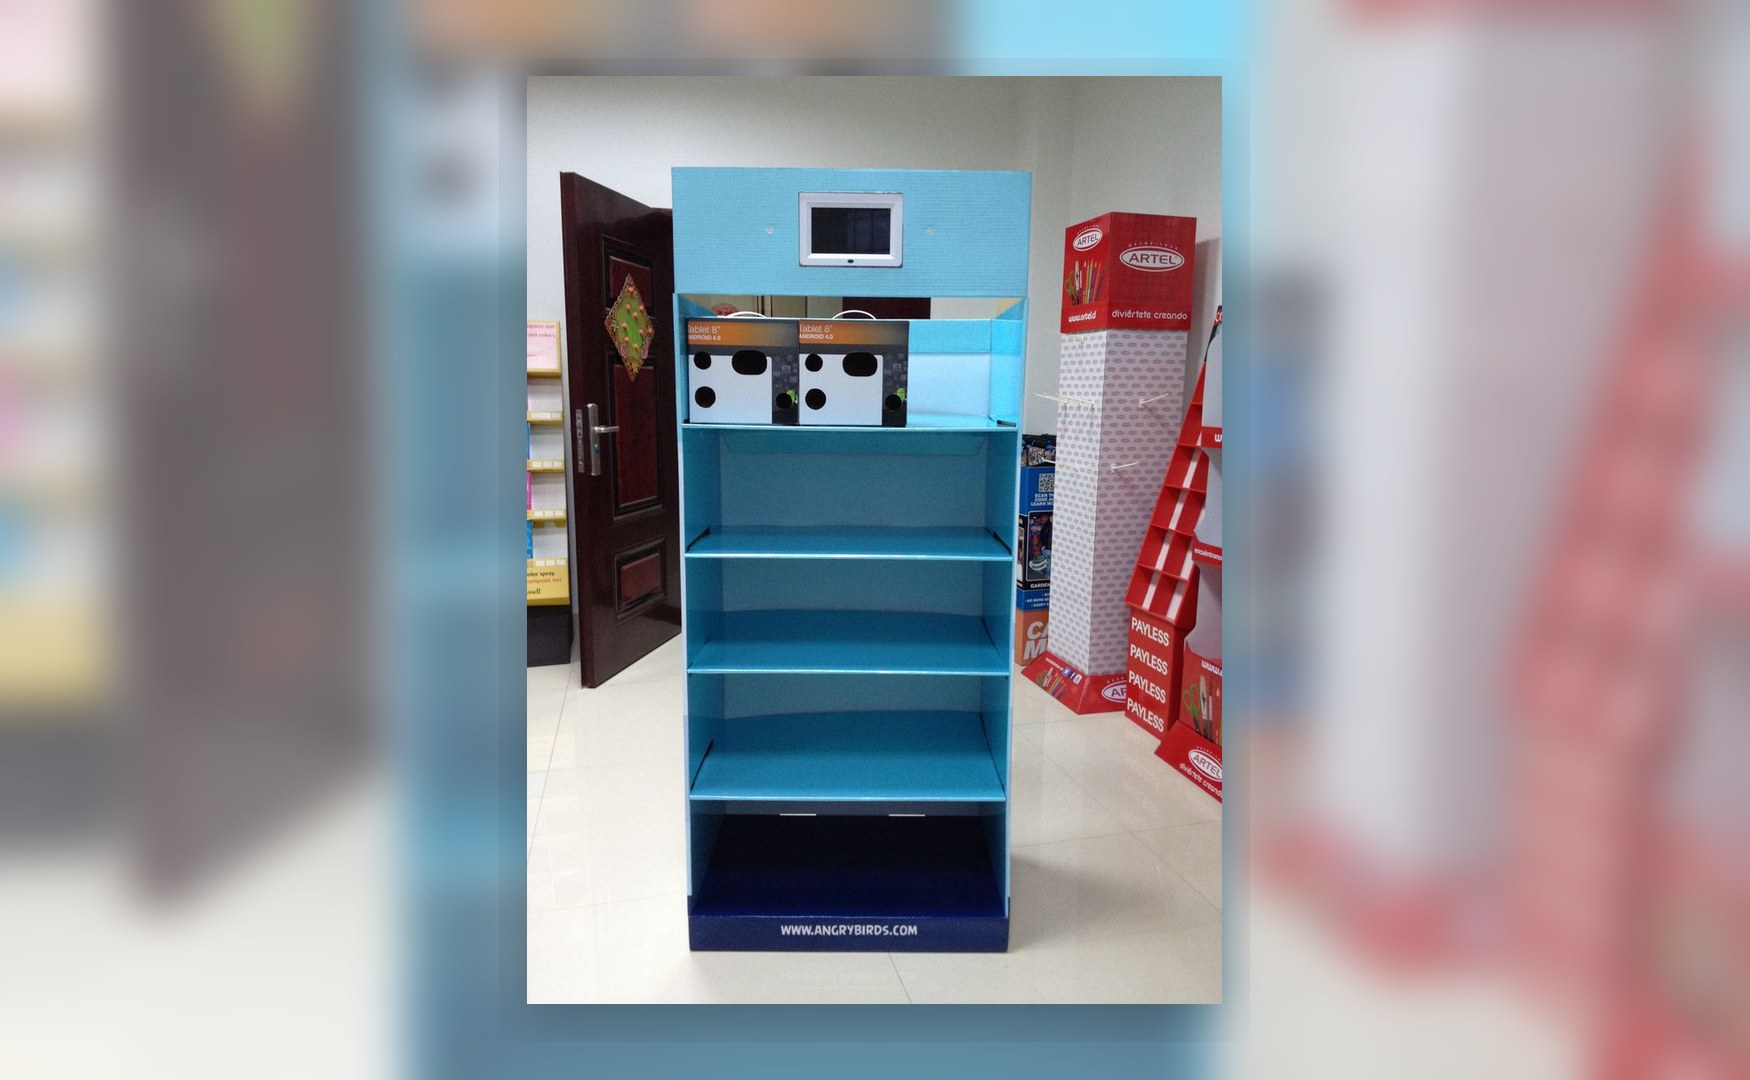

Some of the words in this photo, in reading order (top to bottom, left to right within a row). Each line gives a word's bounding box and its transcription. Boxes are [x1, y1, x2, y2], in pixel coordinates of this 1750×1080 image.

[1077, 233, 1099, 246] ARTEL
[1128, 253, 1177, 265] ARTEL
[1112, 309, 1151, 319] diviértete
[1154, 309, 1188, 320] creando
[1131, 616, 1169, 647] PAYLESS
[1130, 644, 1168, 676] PAYLESS
[1128, 670, 1166, 704] PAYLESS
[1126, 697, 1164, 733] PAYLESS
[1193, 754, 1222, 778] ARTEL
[780, 924, 918, 936] WWW.ANGRYBIRDS.COM
